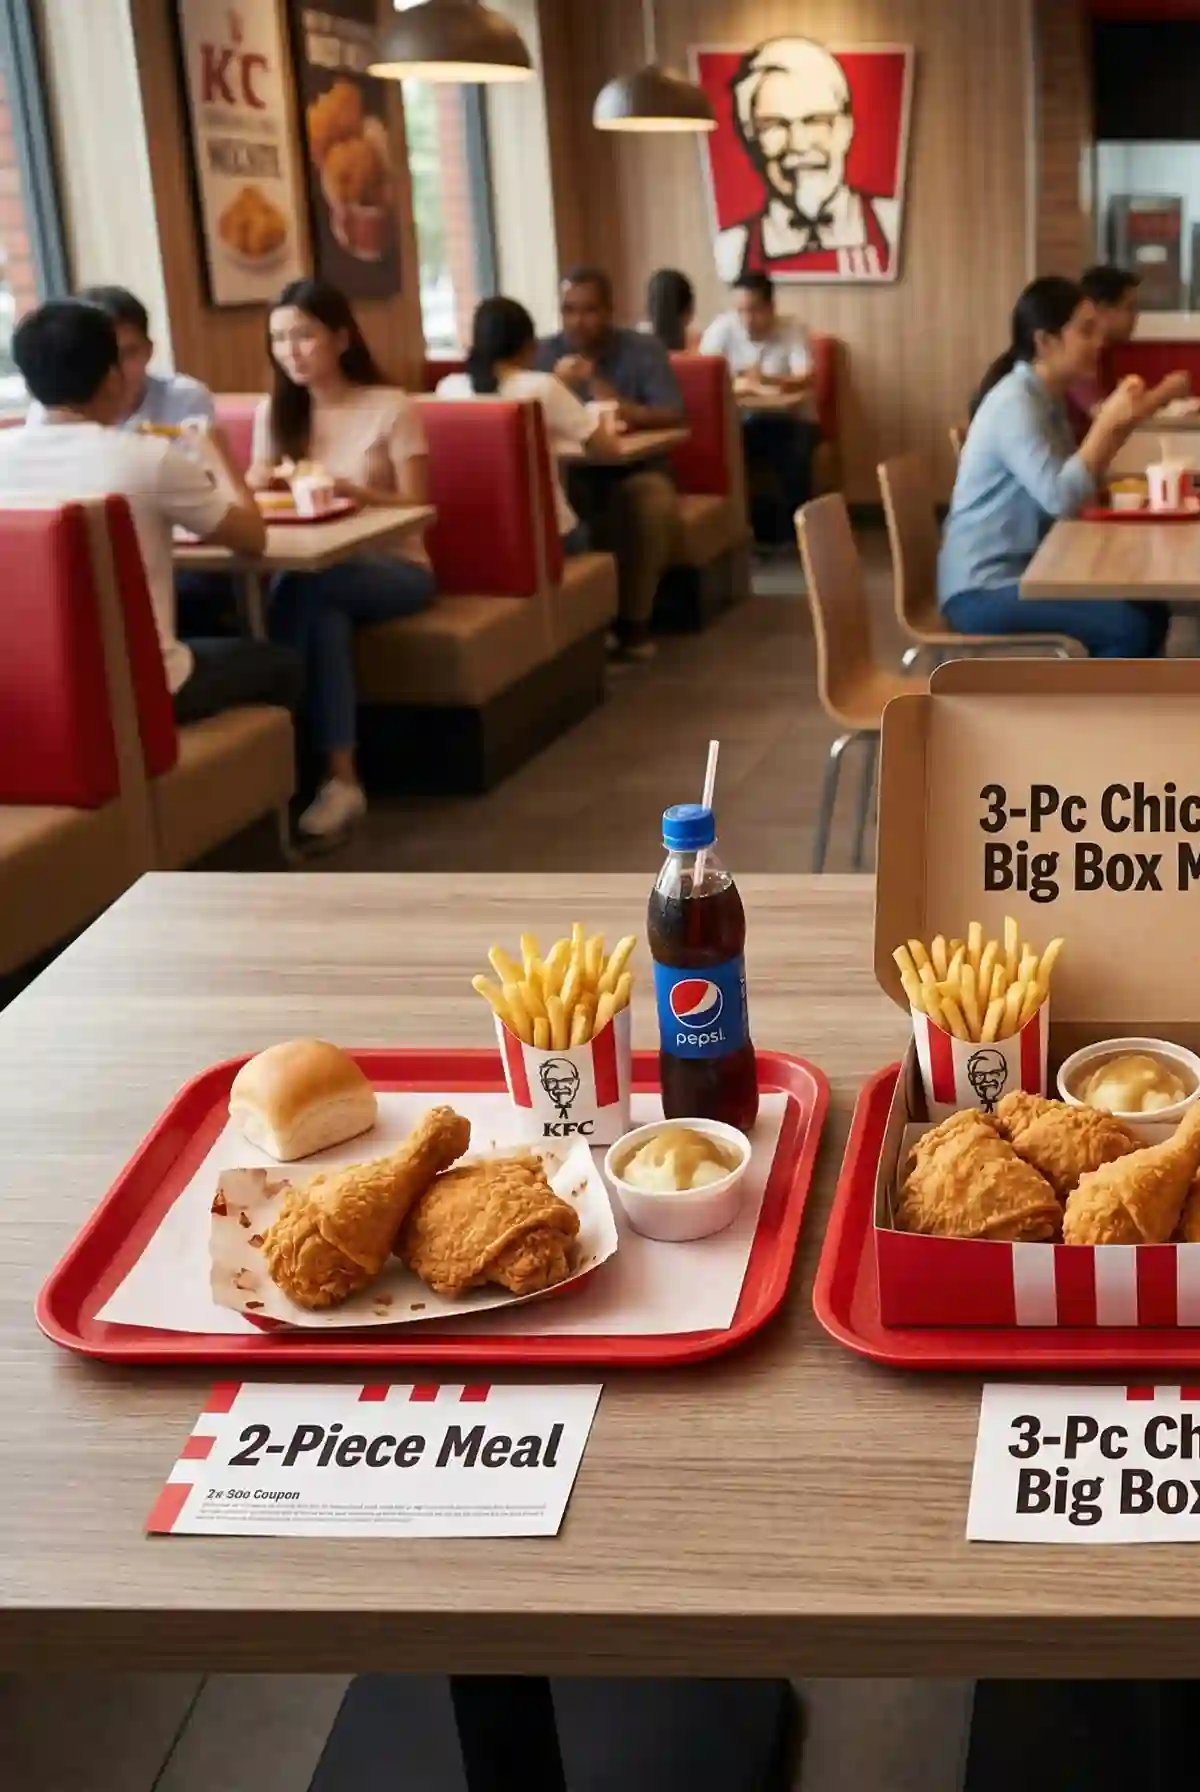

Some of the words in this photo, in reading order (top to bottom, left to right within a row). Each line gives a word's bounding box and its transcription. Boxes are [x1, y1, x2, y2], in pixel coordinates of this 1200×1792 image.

[979, 783, 1087, 833] 3-Pc
[984, 840, 1059, 903] Big
[1074, 842, 1163, 892] Box
[543, 1120, 594, 1136] KFC
[228, 1422, 425, 1468] 2-Piece
[435, 1422, 565, 1468] Meal
[1008, 1414, 1128, 1459] 3-Pc
[254, 1489, 300, 1502] Coupon
[1016, 1466, 1104, 1526] Big
